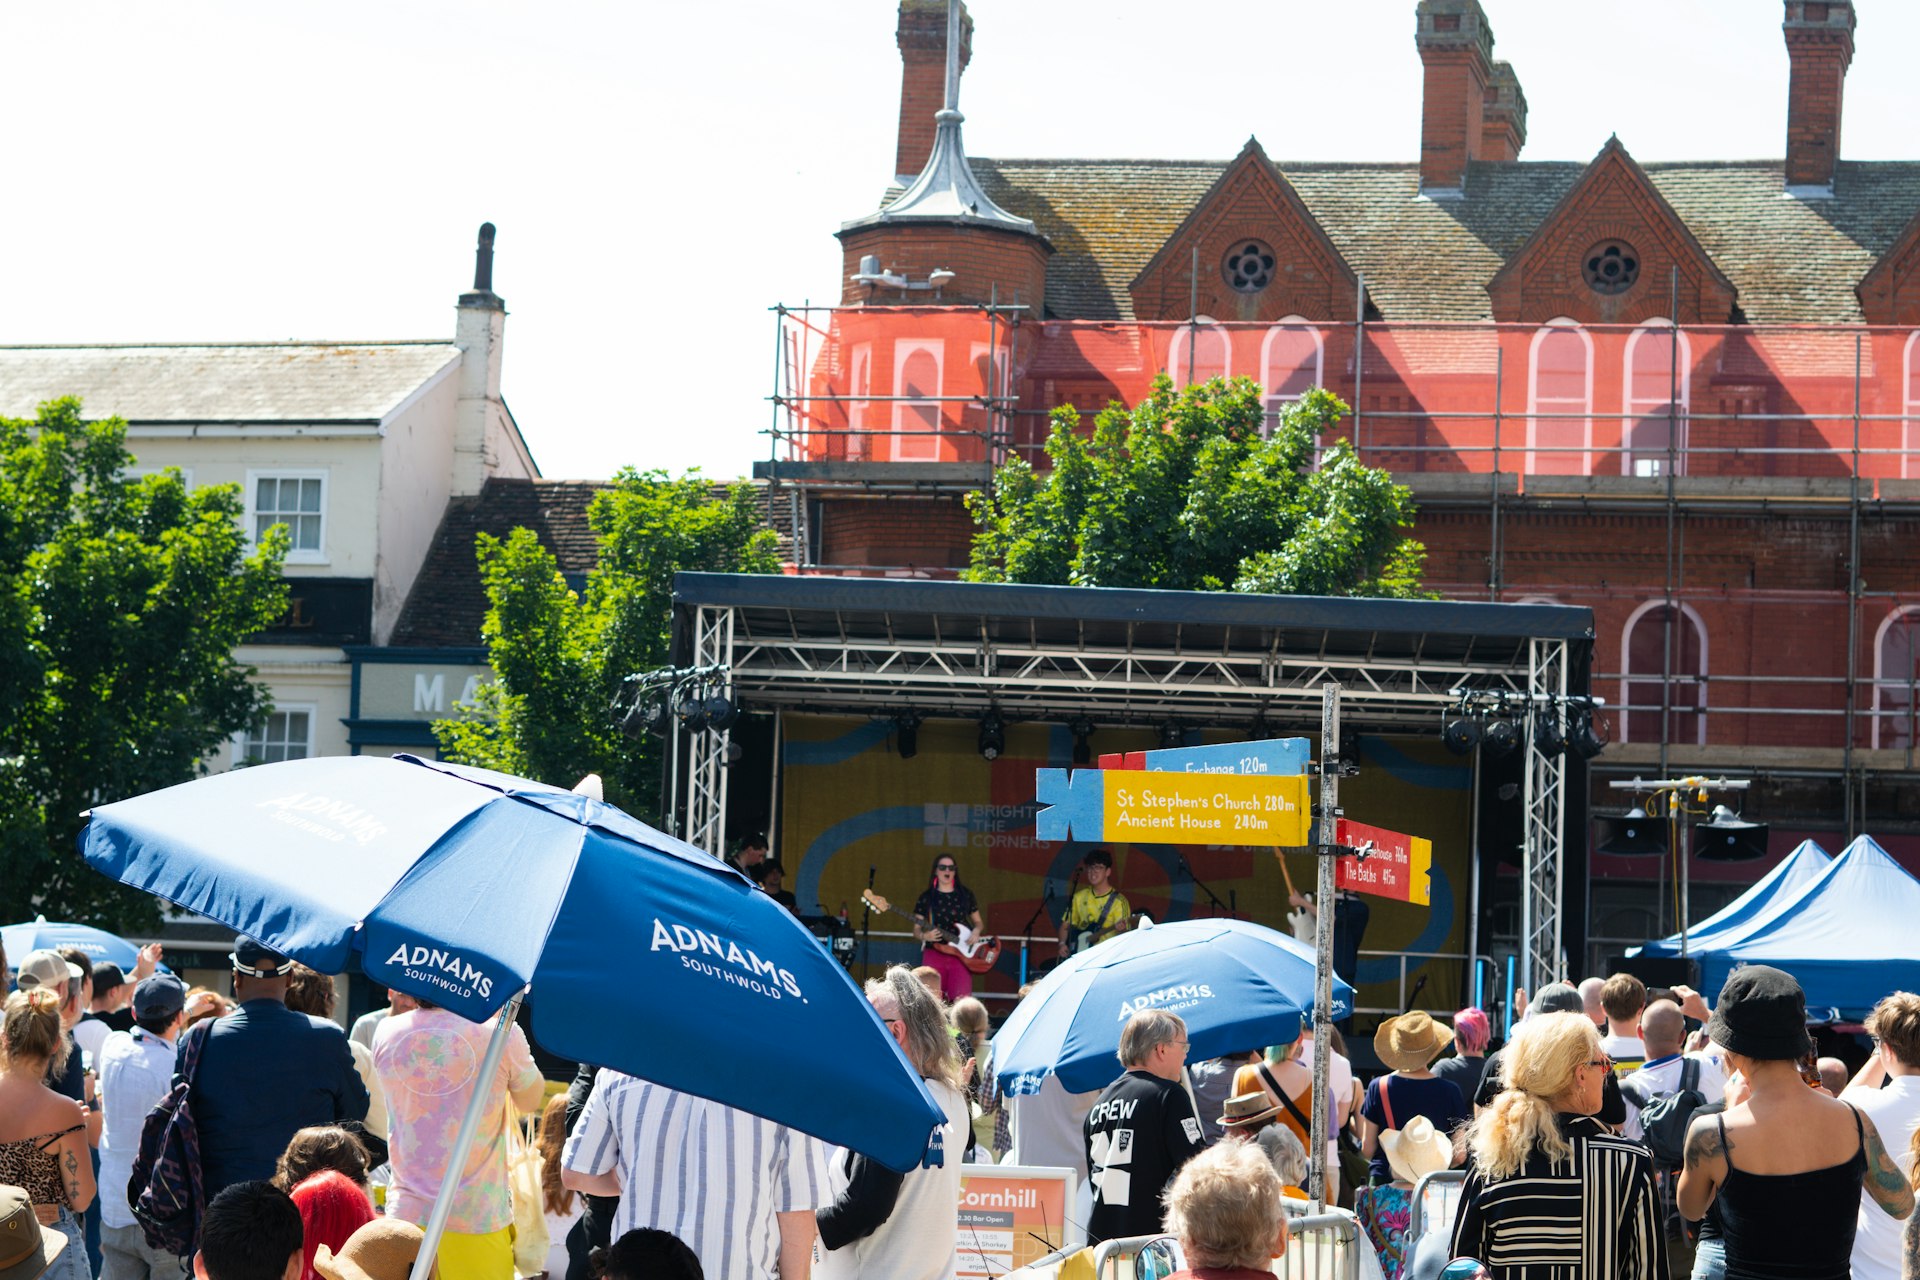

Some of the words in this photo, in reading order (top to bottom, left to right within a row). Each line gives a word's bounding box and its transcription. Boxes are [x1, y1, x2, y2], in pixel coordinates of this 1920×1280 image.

[1240, 757, 1267, 774] 120m
[973, 804, 1041, 818] BRIGHT
[1117, 789, 1134, 807] St
[1142, 790, 1208, 812] Stephen's
[1213, 793, 1261, 811] Church
[1265, 795, 1295, 811] 280m
[974, 820, 1005, 832] THE
[1116, 810, 1175, 828] Ancient
[1180, 814, 1221, 828] House
[1234, 815, 1268, 830] 240m
[972, 835, 1050, 849] CORNERS
[1345, 861, 1357, 880] The
[1358, 863, 1377, 883] Baths
[404, 967, 471, 998] SOUTHWOLD
[681, 955, 781, 1000] SOUTHWOLD
[1090, 1099, 1138, 1125] CREW
[957, 1187, 1036, 1208] Cornhill
